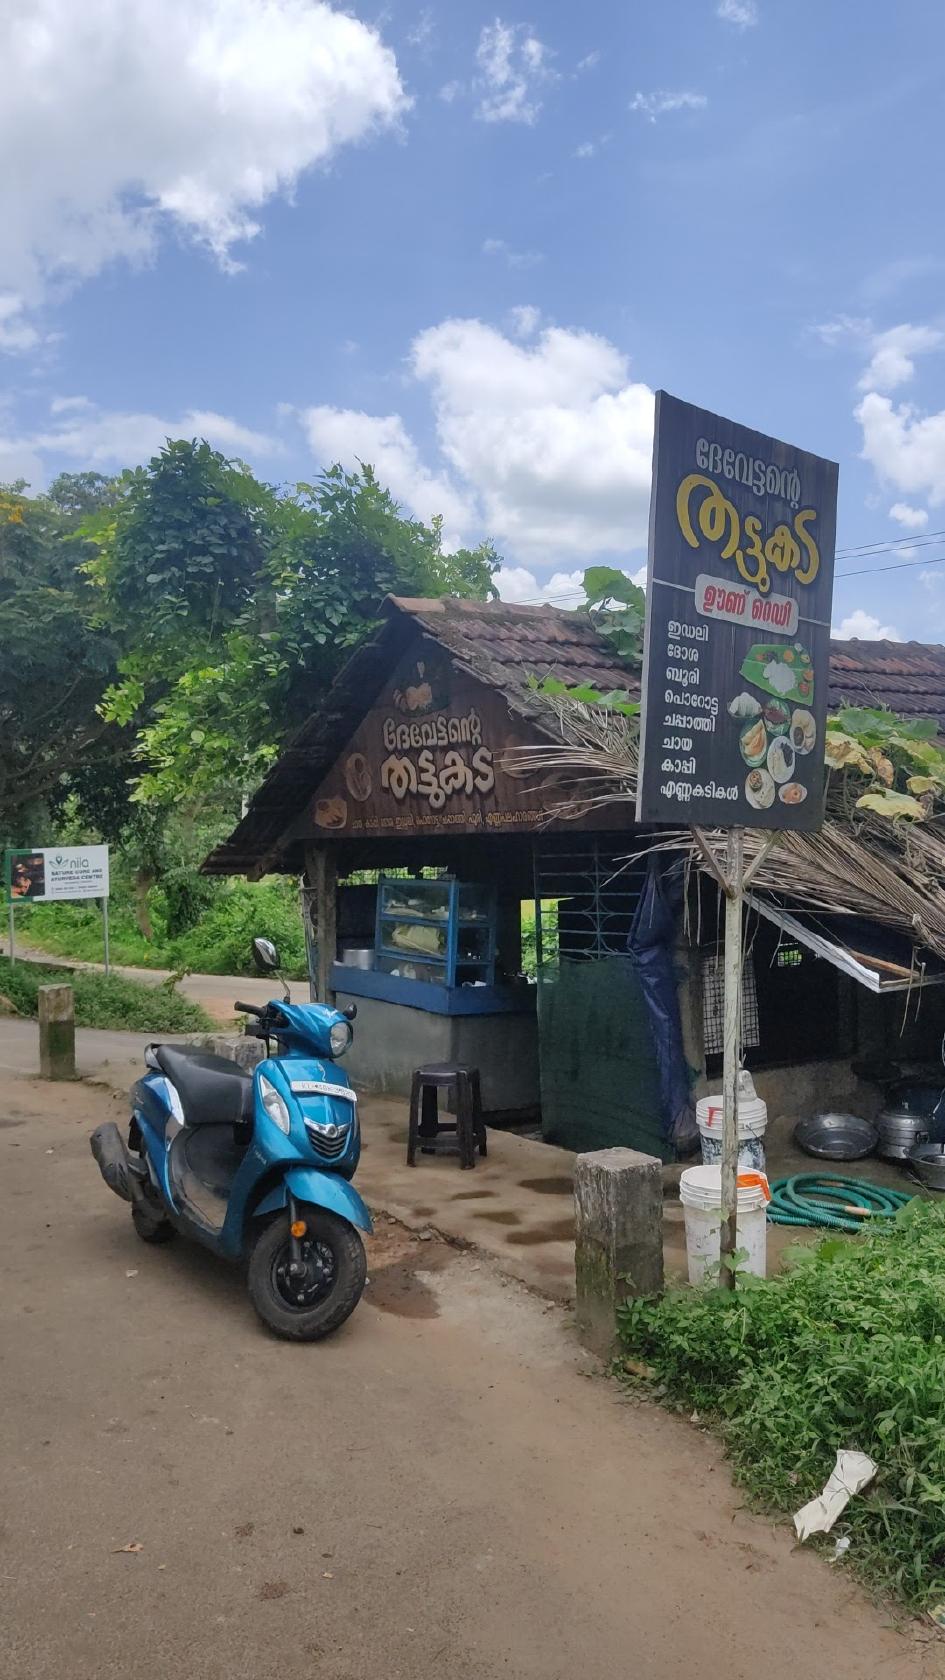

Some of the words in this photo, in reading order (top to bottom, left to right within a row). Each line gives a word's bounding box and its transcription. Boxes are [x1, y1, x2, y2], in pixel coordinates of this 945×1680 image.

[676, 474, 820, 593] തട്ടുകട
[703, 585, 750, 616] ഊണ്
[751, 597, 793, 628] റെഡി
[668, 620, 709, 642] ഇഡലി
[667, 643, 699, 663] ദോശ
[663, 713, 716, 733] ചപ്പാത്തി
[662, 736, 693, 752] ചായ
[661, 756, 697, 775] കാപ്പി
[381, 747, 495, 809] തട്ടുകട
[70, 856, 89, 869] nila
